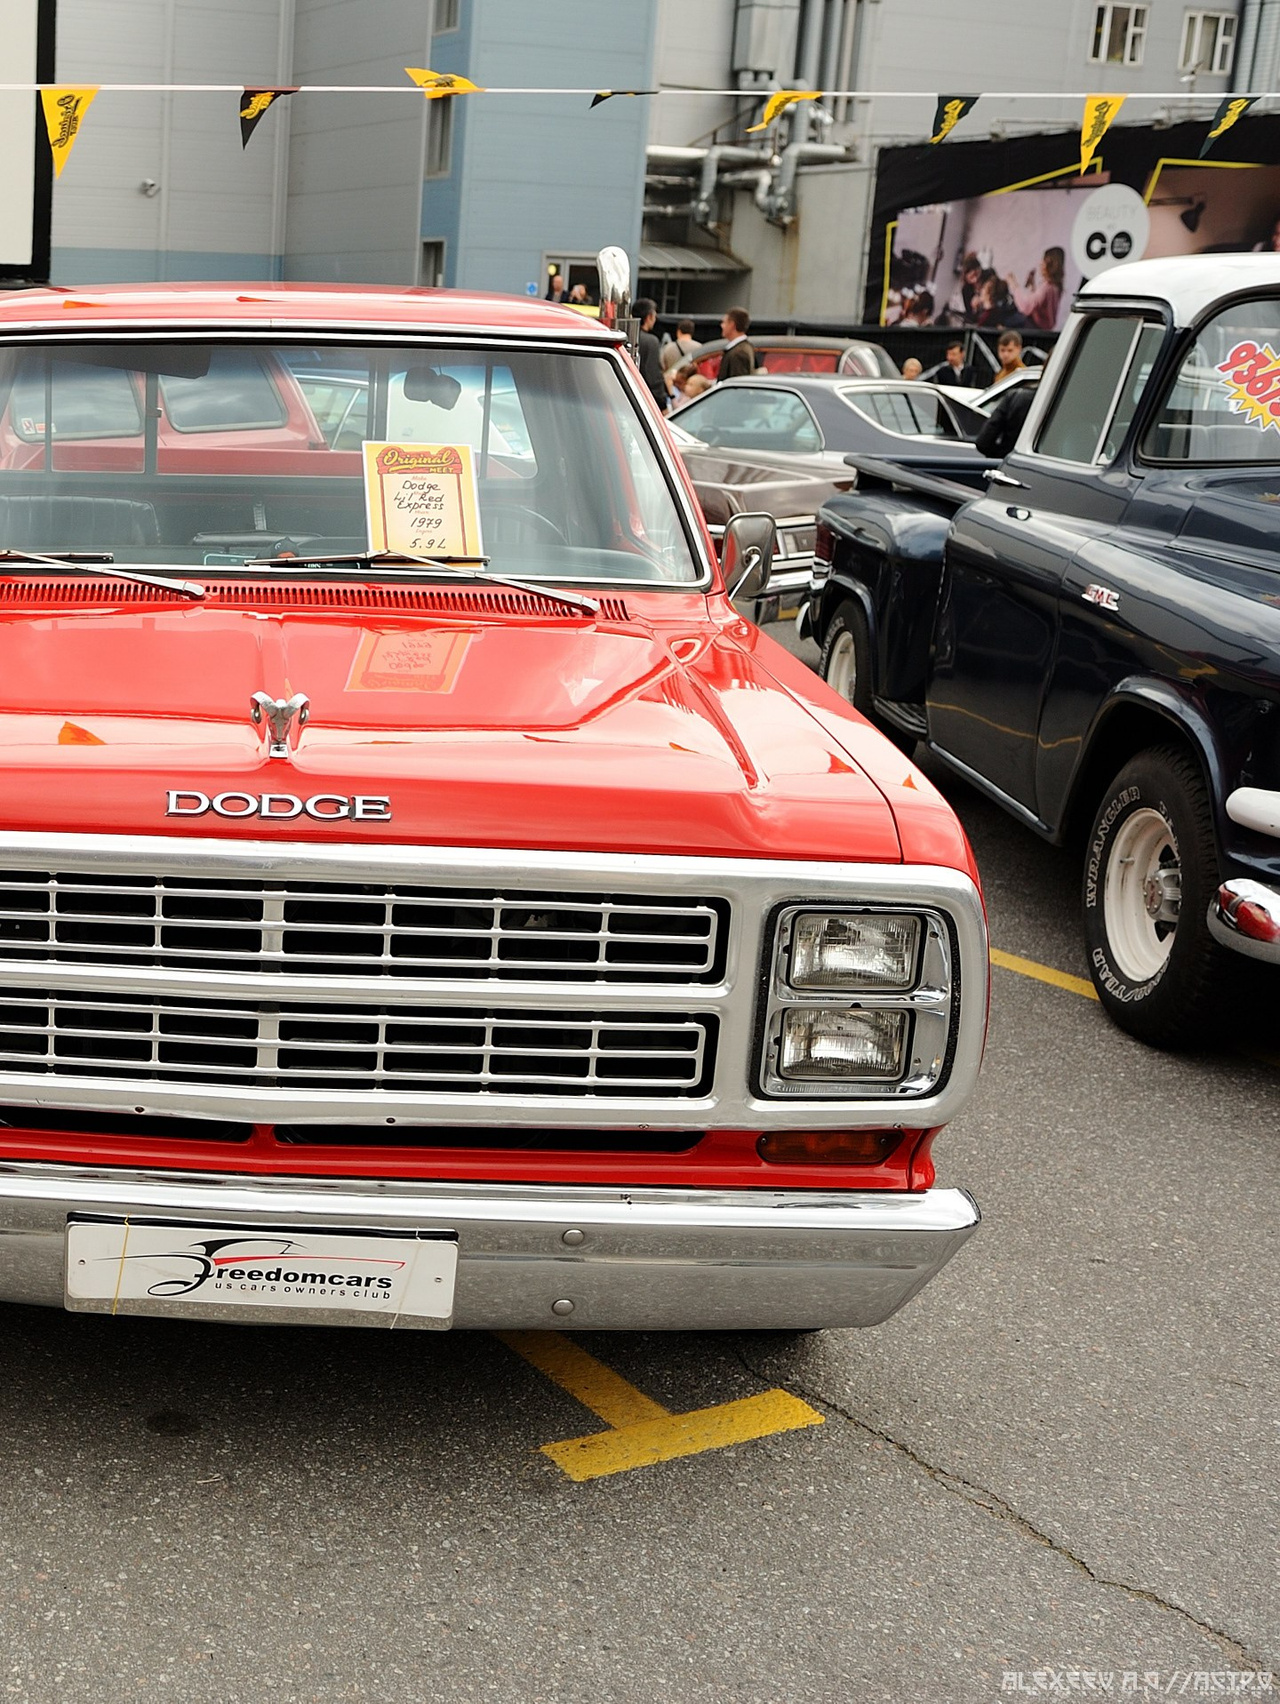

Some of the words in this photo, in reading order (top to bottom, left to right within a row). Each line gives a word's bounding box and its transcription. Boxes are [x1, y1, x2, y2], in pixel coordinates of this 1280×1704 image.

[383, 450, 455, 472] Original
[402, 480, 441, 494] Dodge
[397, 500, 444, 513] Express
[419, 493, 444, 502] Red
[410, 517, 442, 528] 1979
[1081, 584, 1120, 611] GMC
[165, 790, 392, 822] DODGE
[1086, 786, 1140, 908] WRANGLER
[215, 1281, 232, 1290] us
[240, 1283, 277, 1293] cars
[284, 1285, 346, 1296] owners
[354, 1287, 391, 1299] club
